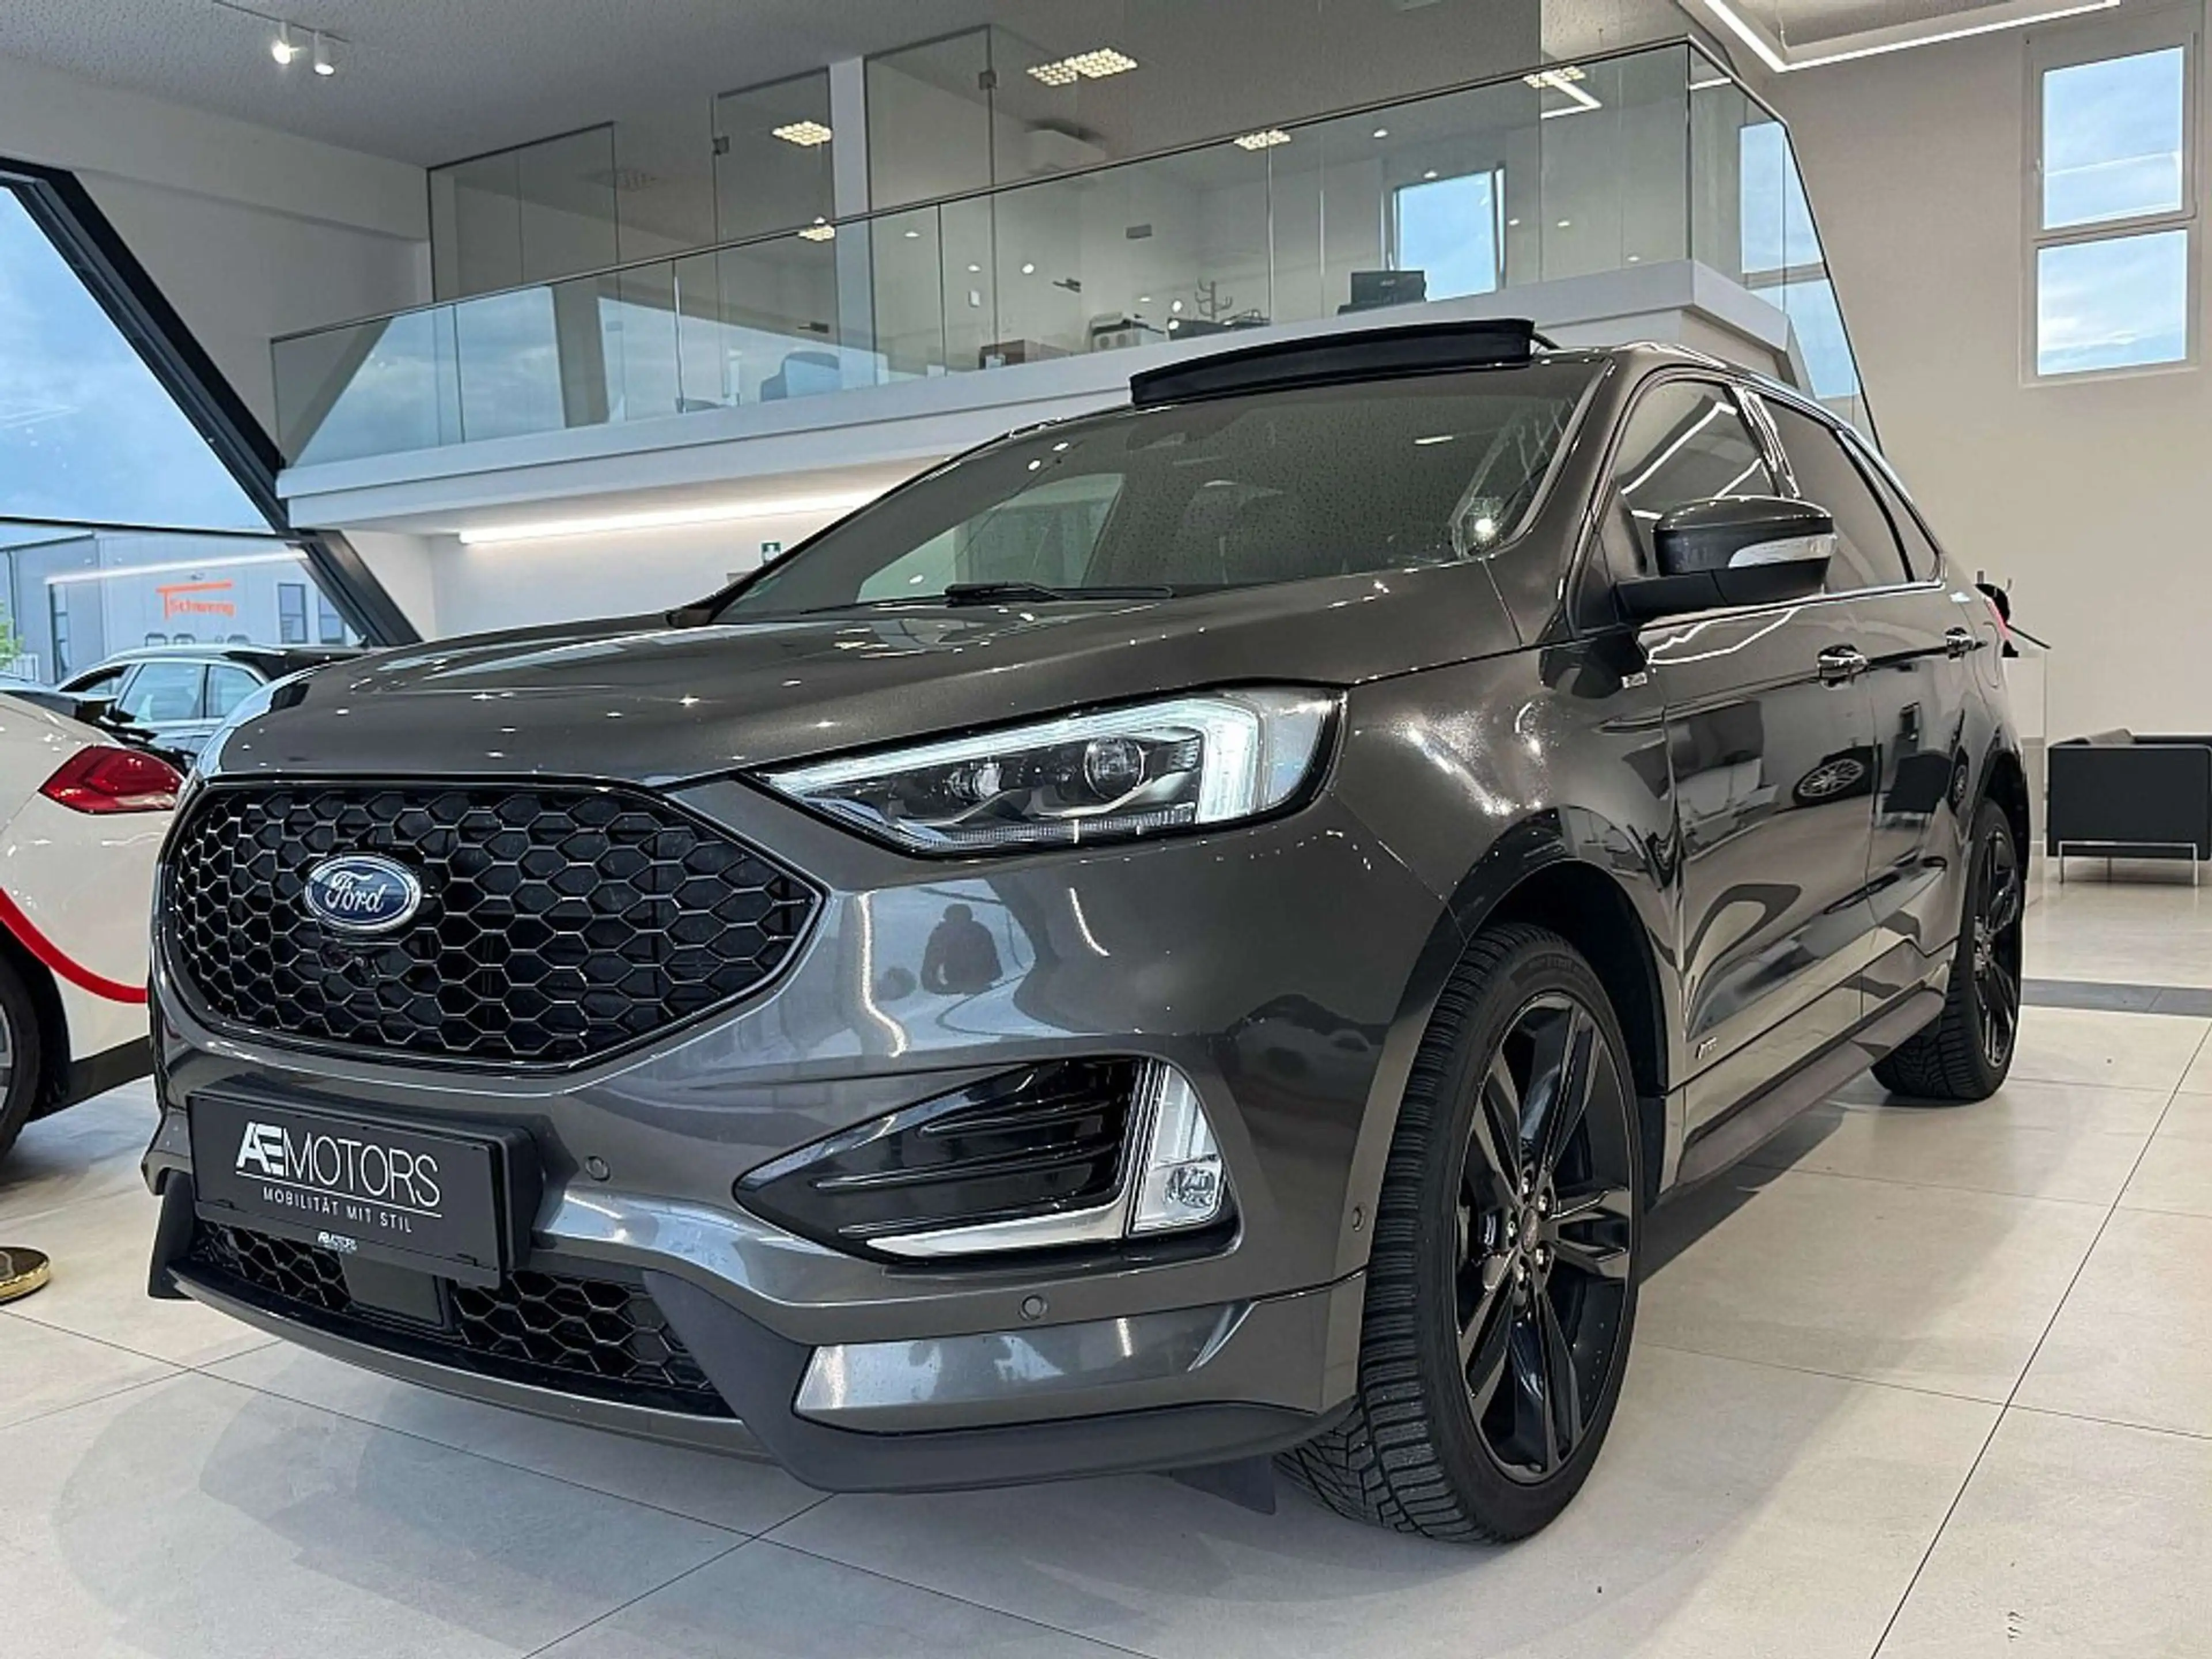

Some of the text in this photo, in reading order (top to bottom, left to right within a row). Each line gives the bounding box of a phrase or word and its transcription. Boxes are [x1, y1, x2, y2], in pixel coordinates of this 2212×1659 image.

[324, 870, 388, 913] Ford
[347, 1206, 372, 1224] MIT
[380, 1212, 412, 1233] STIL
